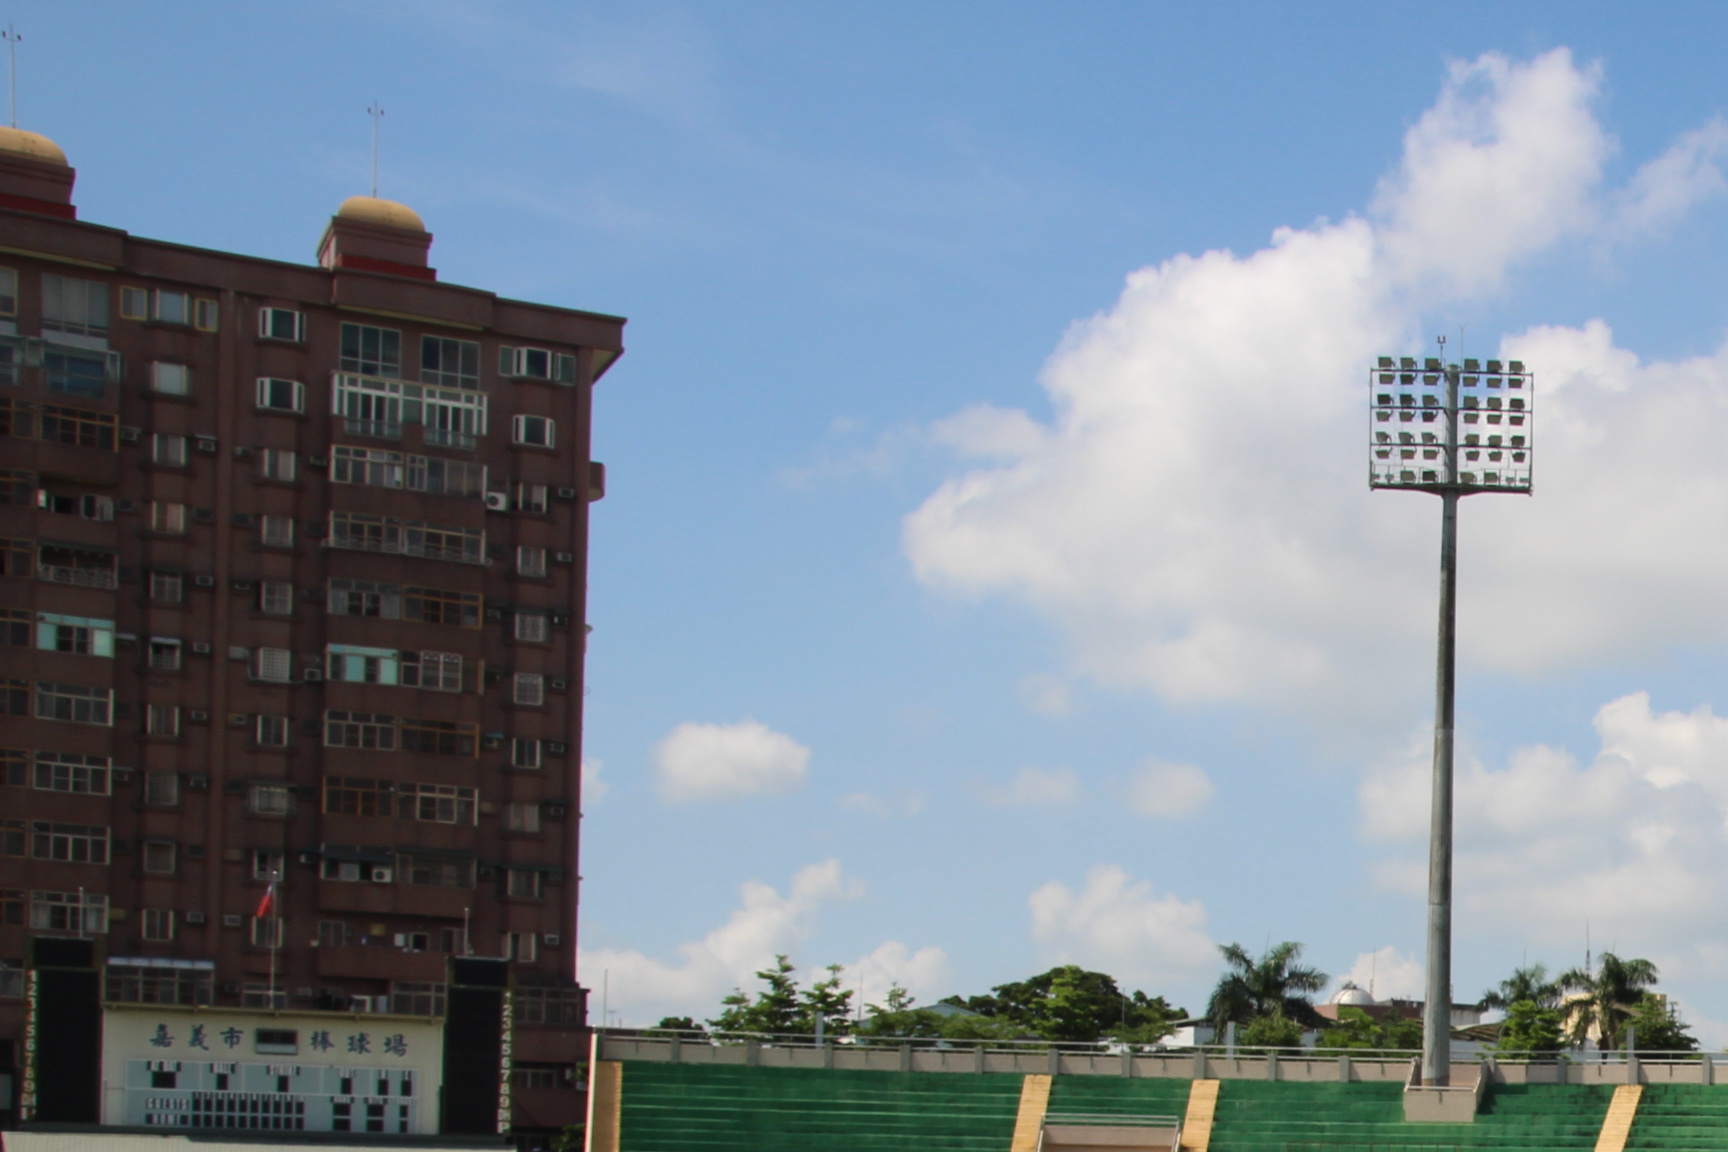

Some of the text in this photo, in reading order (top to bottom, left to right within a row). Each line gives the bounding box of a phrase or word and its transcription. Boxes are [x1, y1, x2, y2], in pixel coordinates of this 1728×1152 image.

[150, 1023, 409, 1057] 嘉義市 棒球場
